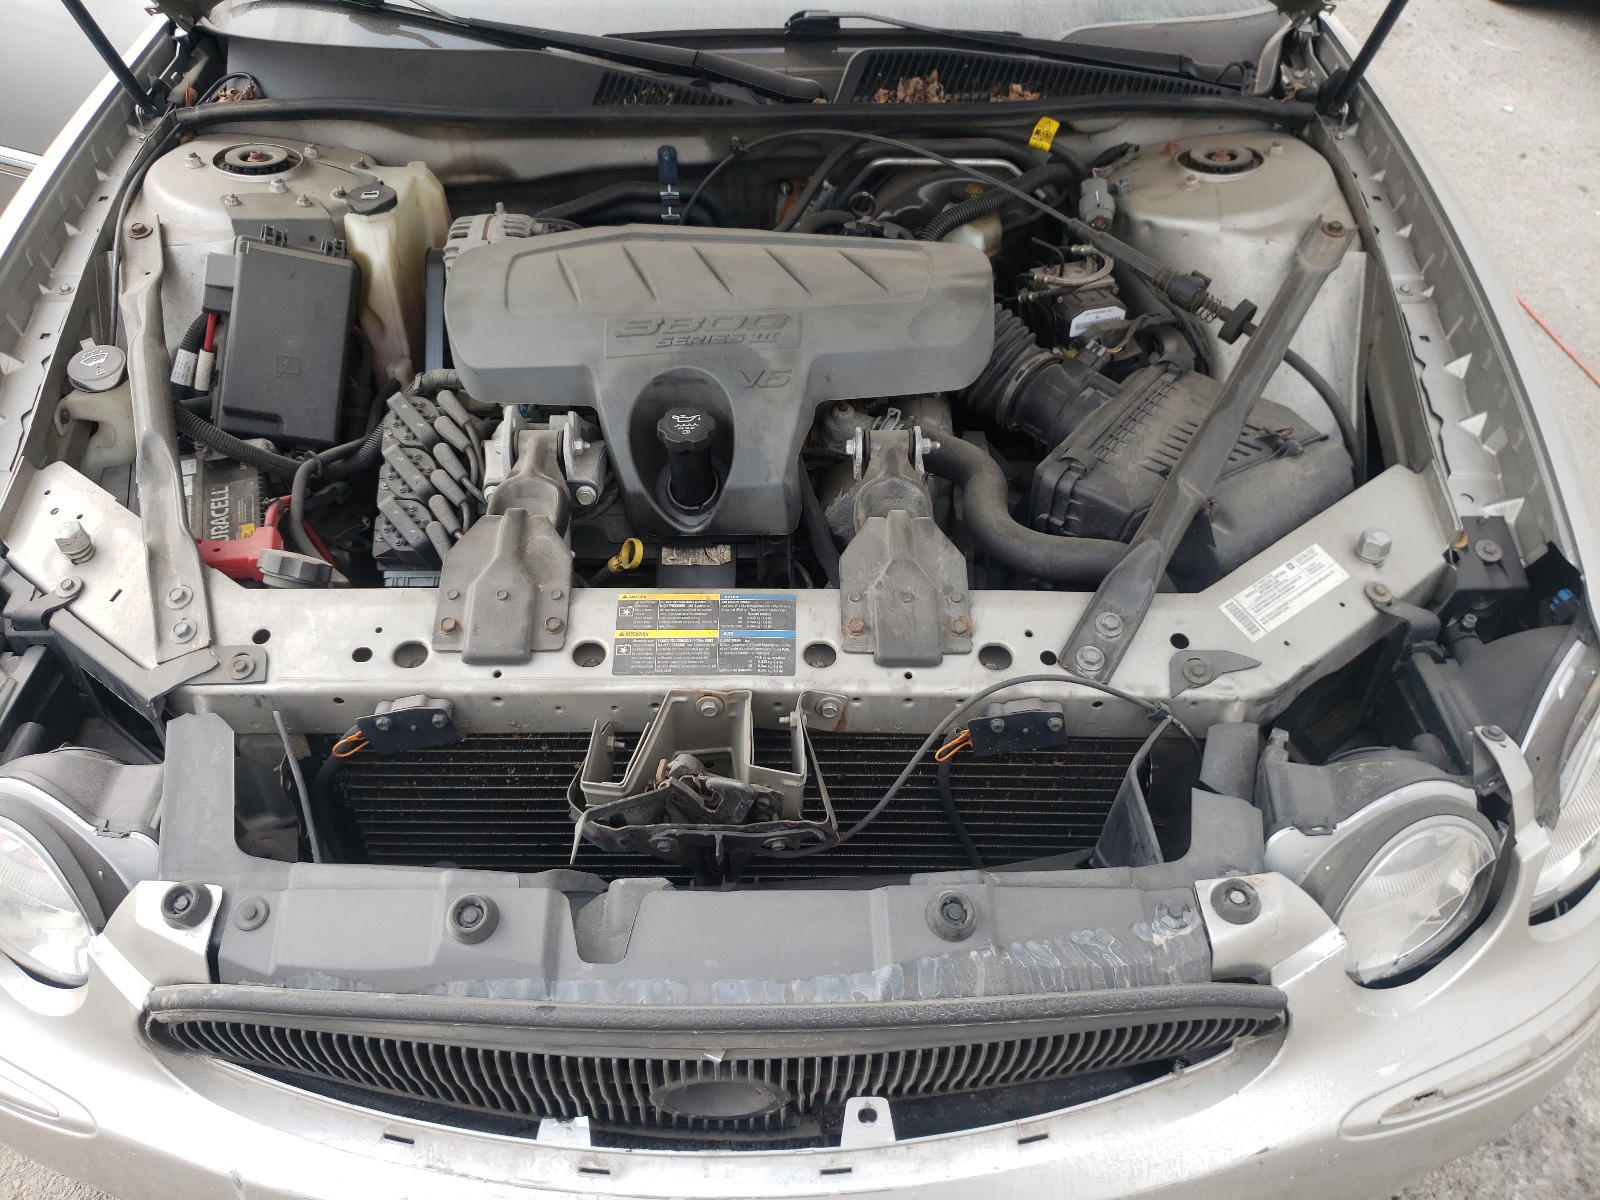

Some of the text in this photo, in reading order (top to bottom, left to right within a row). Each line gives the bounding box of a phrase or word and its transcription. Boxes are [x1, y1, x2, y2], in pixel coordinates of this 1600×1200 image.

[616, 314, 790, 338] 3800
[655, 334, 745, 348] SERIES
[738, 368, 793, 389] V6
[210, 485, 230, 541] URACELL
